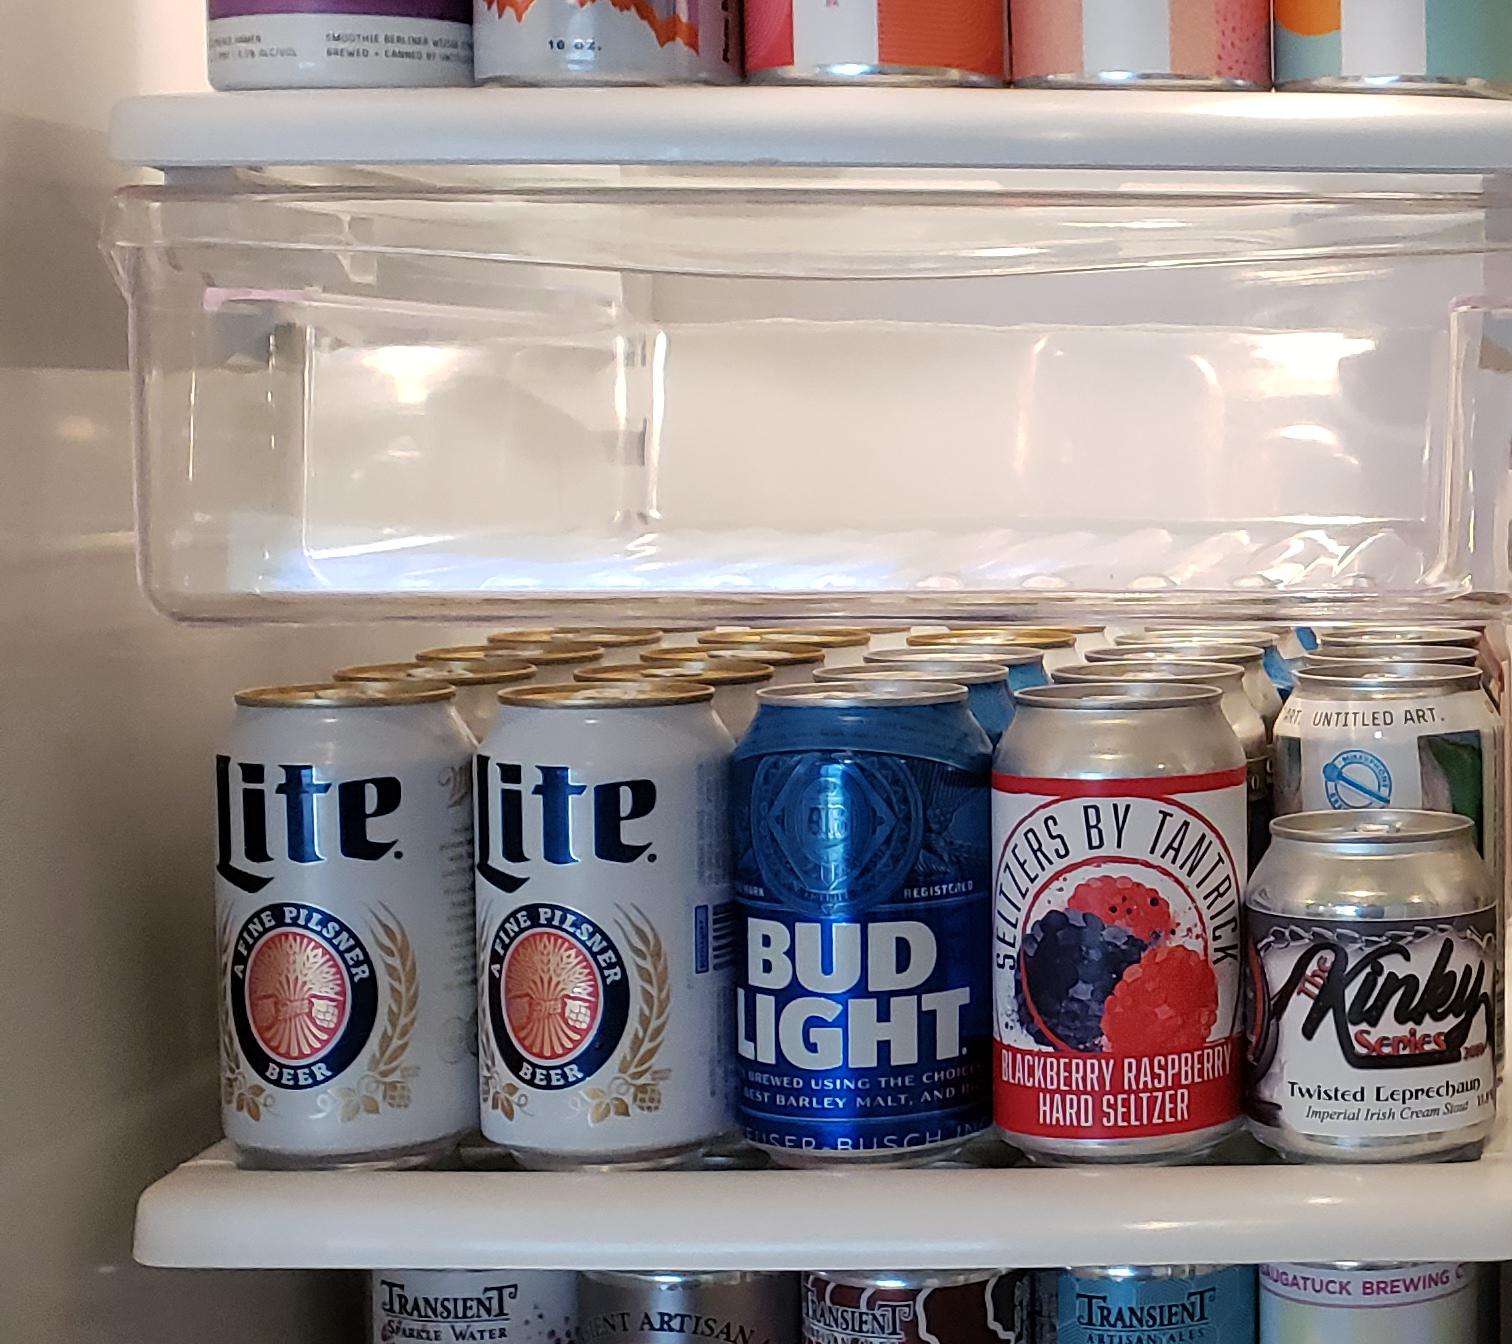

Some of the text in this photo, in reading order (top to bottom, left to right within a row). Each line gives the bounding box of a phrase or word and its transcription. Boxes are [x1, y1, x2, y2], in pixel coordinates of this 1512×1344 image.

[1313, 710, 1394, 728] UNTITLED
[995, 803, 1239, 971] SELTZERS BY TANTRICK
[233, 905, 371, 984] A FINE PILSNER
[491, 906, 623, 986] A FINE PILSNER
[747, 917, 937, 994] BUD
[1269, 937, 1494, 1069] Kinky
[1354, 1027, 1448, 1056] Series
[265, 1062, 333, 1086] BEER
[519, 1061, 585, 1087] BEER
[748, 1072, 915, 1090] BREWED USING THE
[1001, 1043, 1232, 1092] BLACKBERRY RASPBERRY
[776, 1094, 847, 1109] BARLEY
[920, 1087, 956, 1103] AND
[1288, 1081, 1365, 1103] Twisted
[1376, 1077, 1482, 1104] Leprechaun
[1038, 1088, 1189, 1128] HARD SELTZER
[1305, 1106, 1362, 1123] Imperial
[1364, 1107, 1396, 1121] Irish
[1399, 1105, 1441, 1121] Cream
[1361, 1269, 1450, 1296] BREWING
[381, 1279, 518, 1321] TRANSIENT
[1076, 1286, 1216, 1330] TRANSIENT
[387, 1319, 508, 1341] SPARKLE WATER
[1167, 1328, 1206, 1344] ALES
